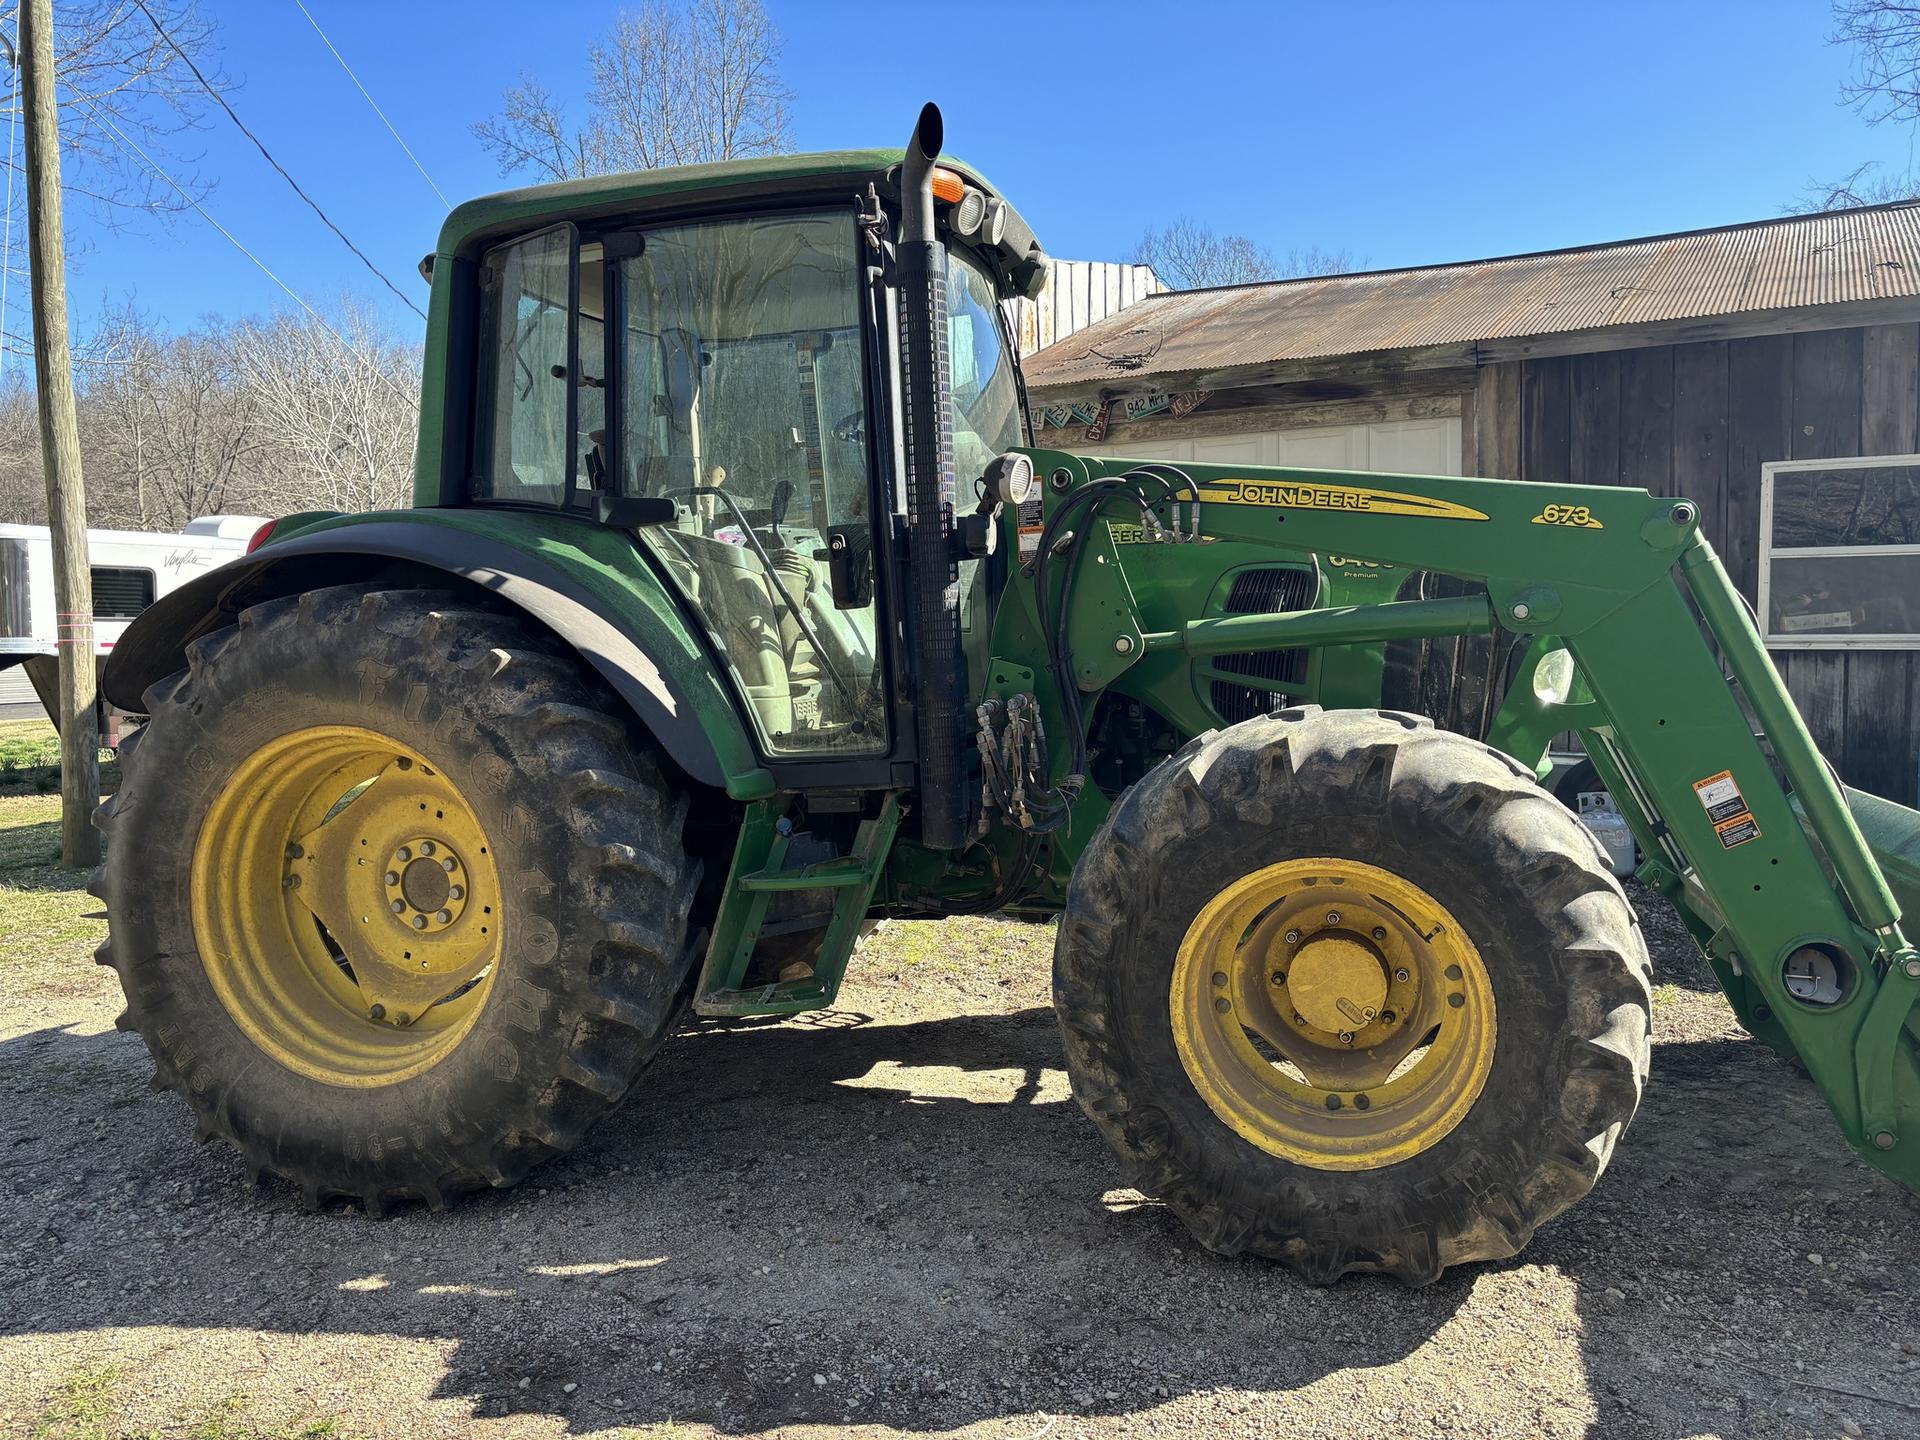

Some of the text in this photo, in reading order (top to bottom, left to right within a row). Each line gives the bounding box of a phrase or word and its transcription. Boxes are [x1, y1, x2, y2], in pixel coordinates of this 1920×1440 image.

[1127, 398, 1146, 415] 942
[1088, 420, 1104, 440] 543
[1228, 482, 1371, 509] JOHN DEERE
[1543, 502, 1591, 525] 673
[1110, 530, 1144, 542] EER
[1344, 571, 1378, 579] Premium
[1702, 772, 1727, 786] WARNING
[1725, 815, 1749, 829] WARNING
[354, 657, 561, 1082] Firestone
